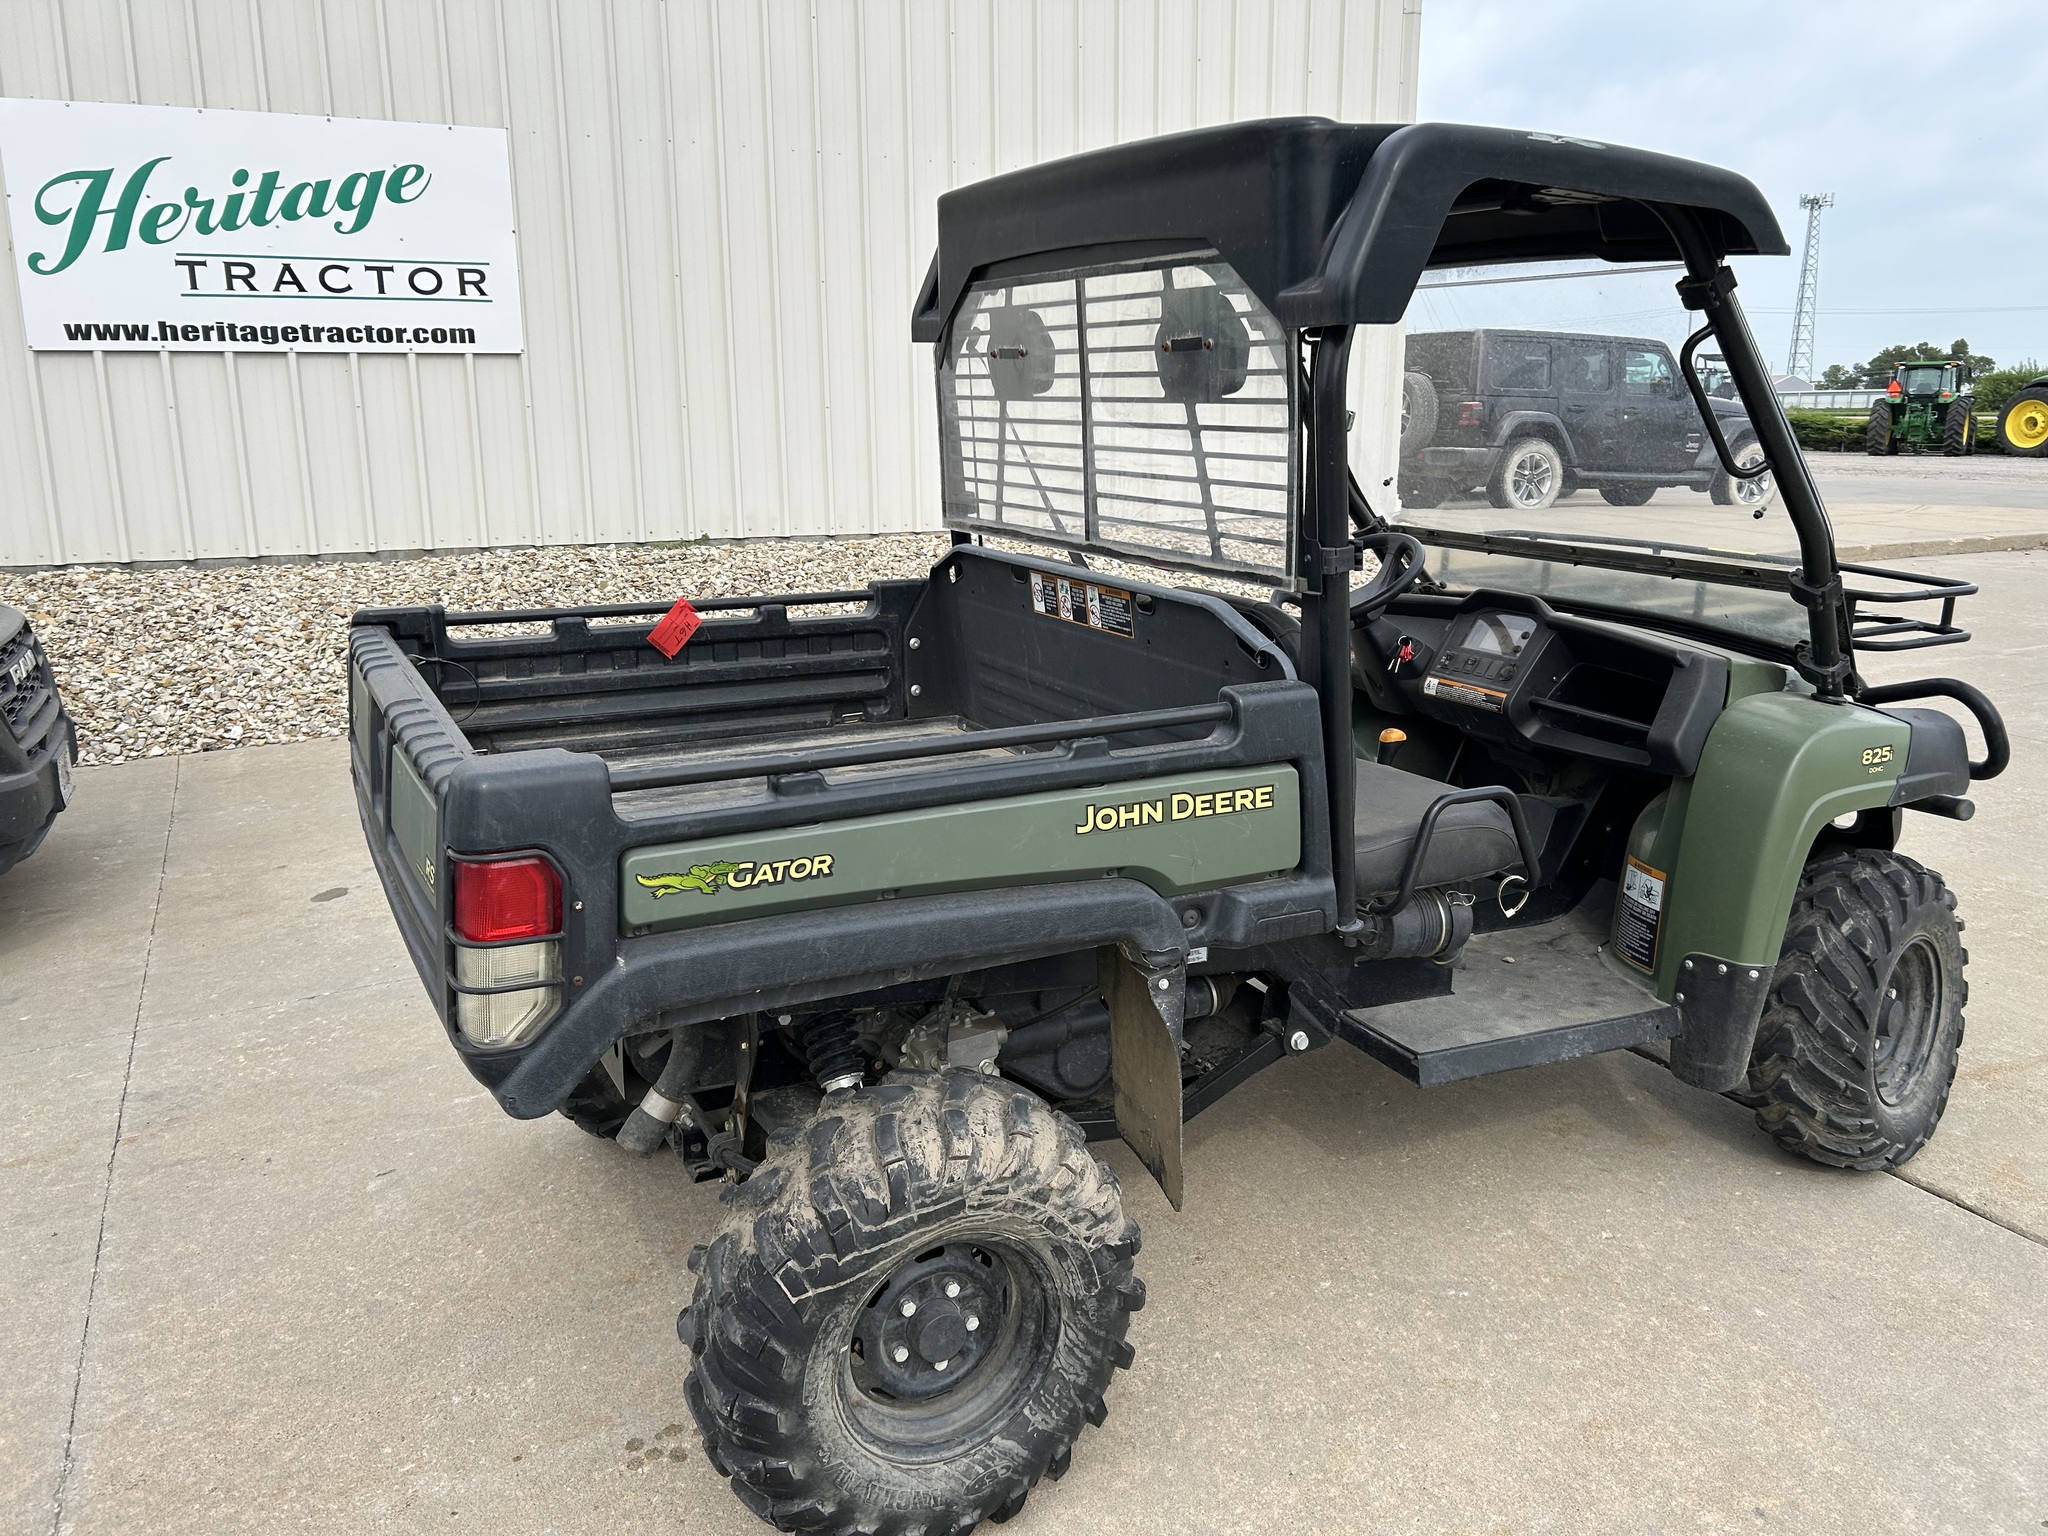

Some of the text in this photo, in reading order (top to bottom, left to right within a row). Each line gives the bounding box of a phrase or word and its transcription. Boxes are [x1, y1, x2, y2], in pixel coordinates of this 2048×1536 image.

[27, 156, 433, 276] Heritage
[174, 258, 491, 298] TRACTOR
[62, 320, 477, 345] www.heritagetractor.com
[1862, 745, 1894, 766] 825i
[1076, 784, 1275, 836] JOHN DEERE
[725, 853, 834, 893] GATOR
